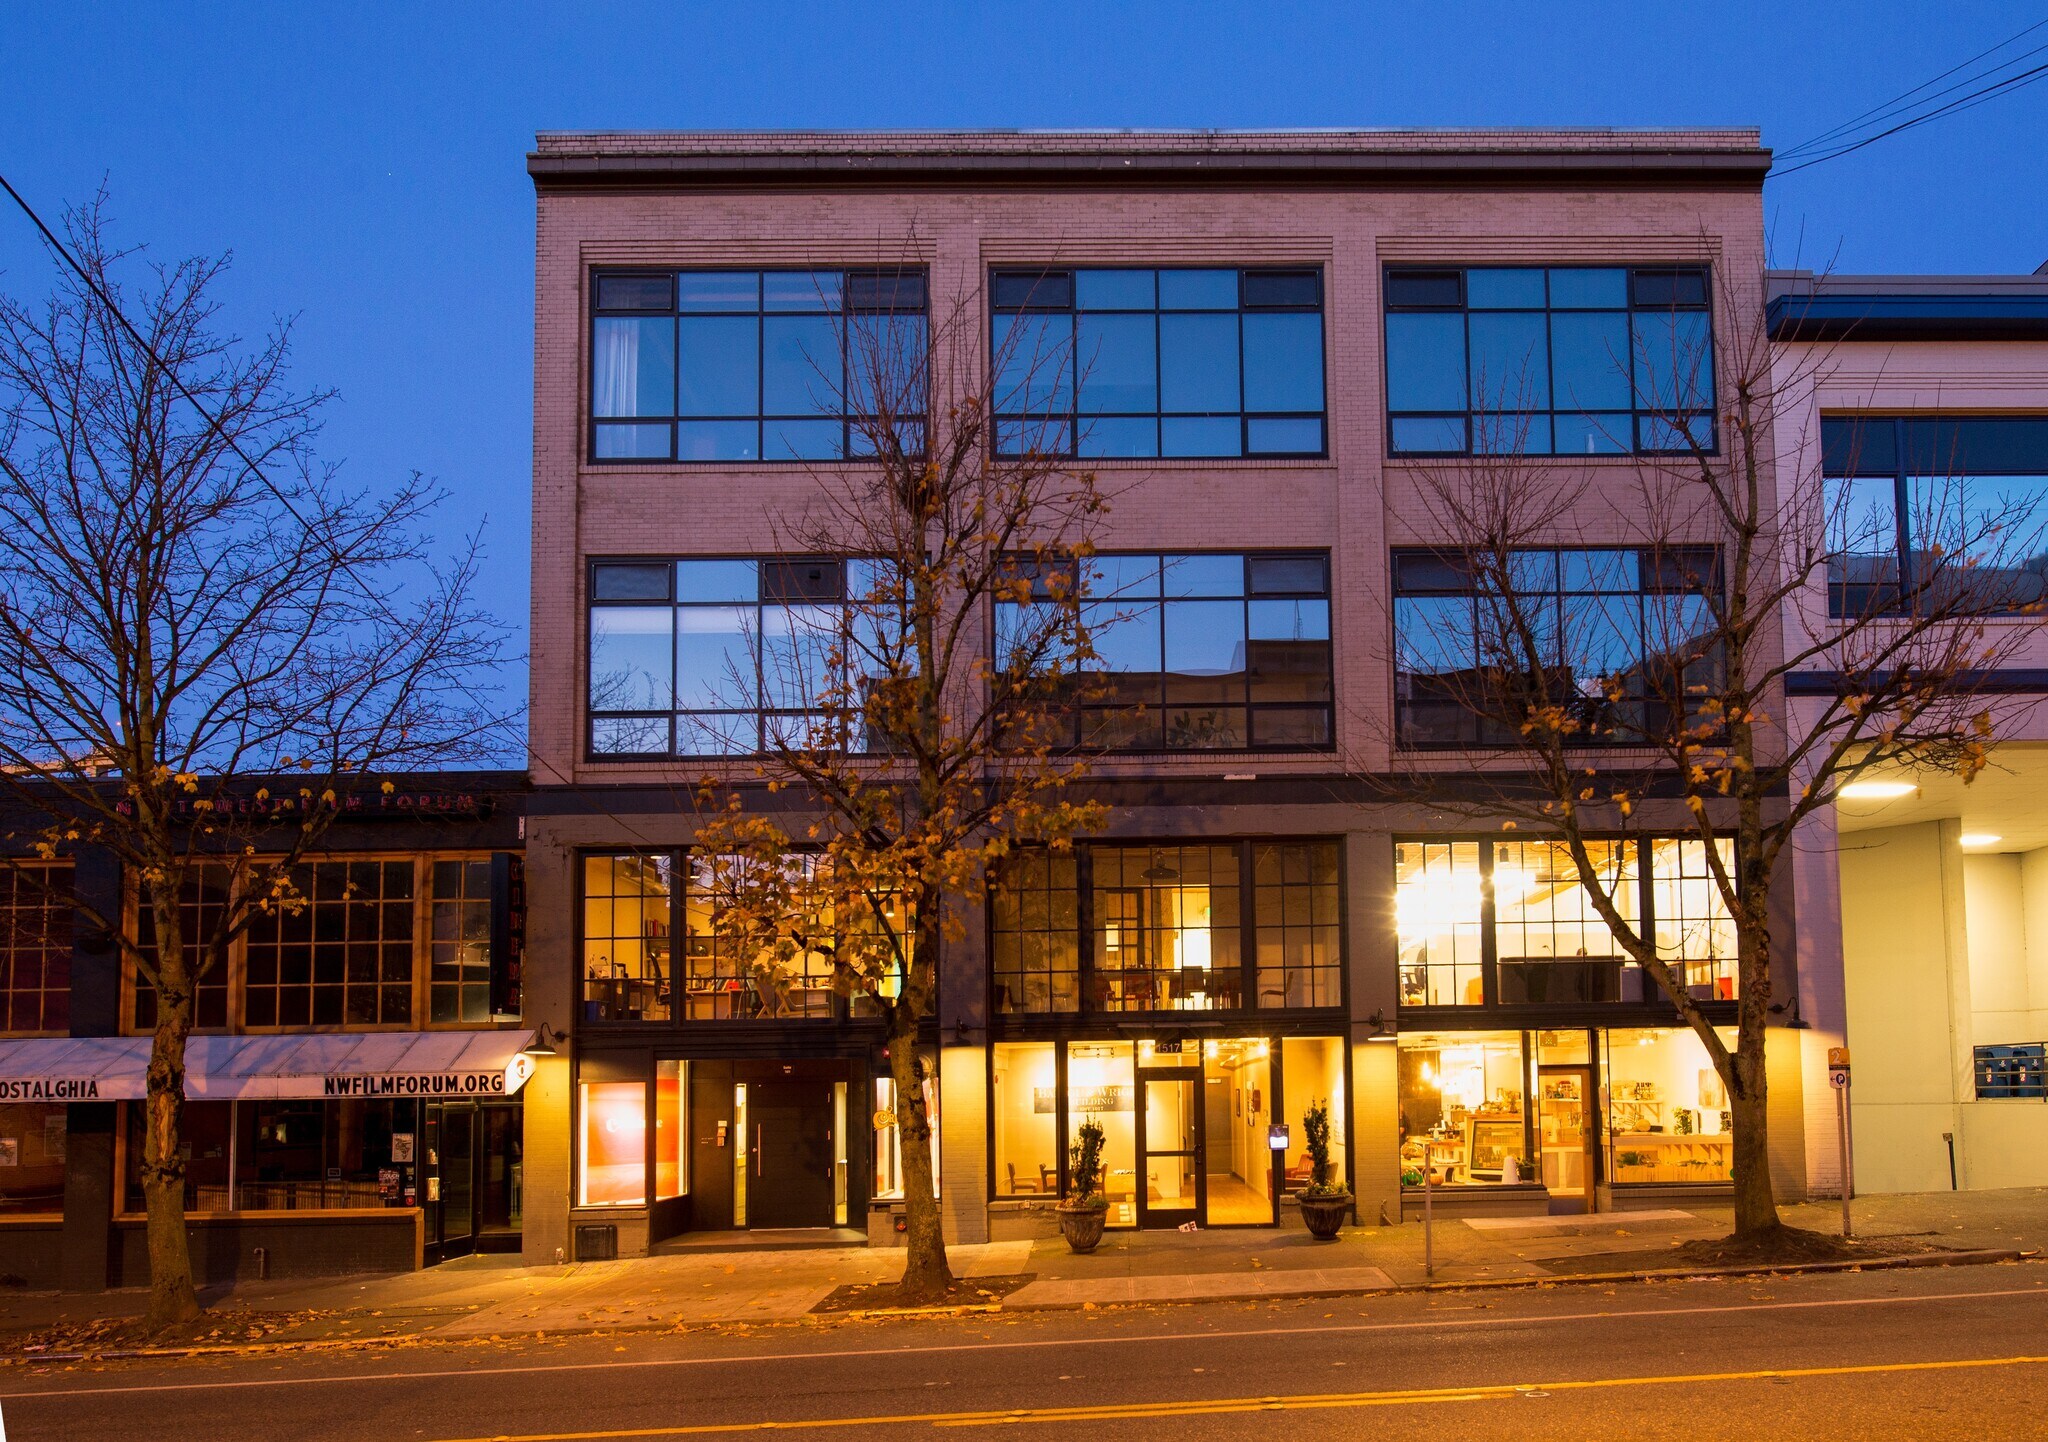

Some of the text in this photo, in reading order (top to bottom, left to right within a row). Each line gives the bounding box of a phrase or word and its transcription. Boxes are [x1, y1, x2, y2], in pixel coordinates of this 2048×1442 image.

[116, 798, 285, 815] NTWEST
[381, 794, 474, 810] FORUM
[1156, 1043, 1180, 1053] 1517
[0, 1081, 98, 1098] OSTALGHIA
[324, 1074, 502, 1095] NWFILMFORUM.ORG
